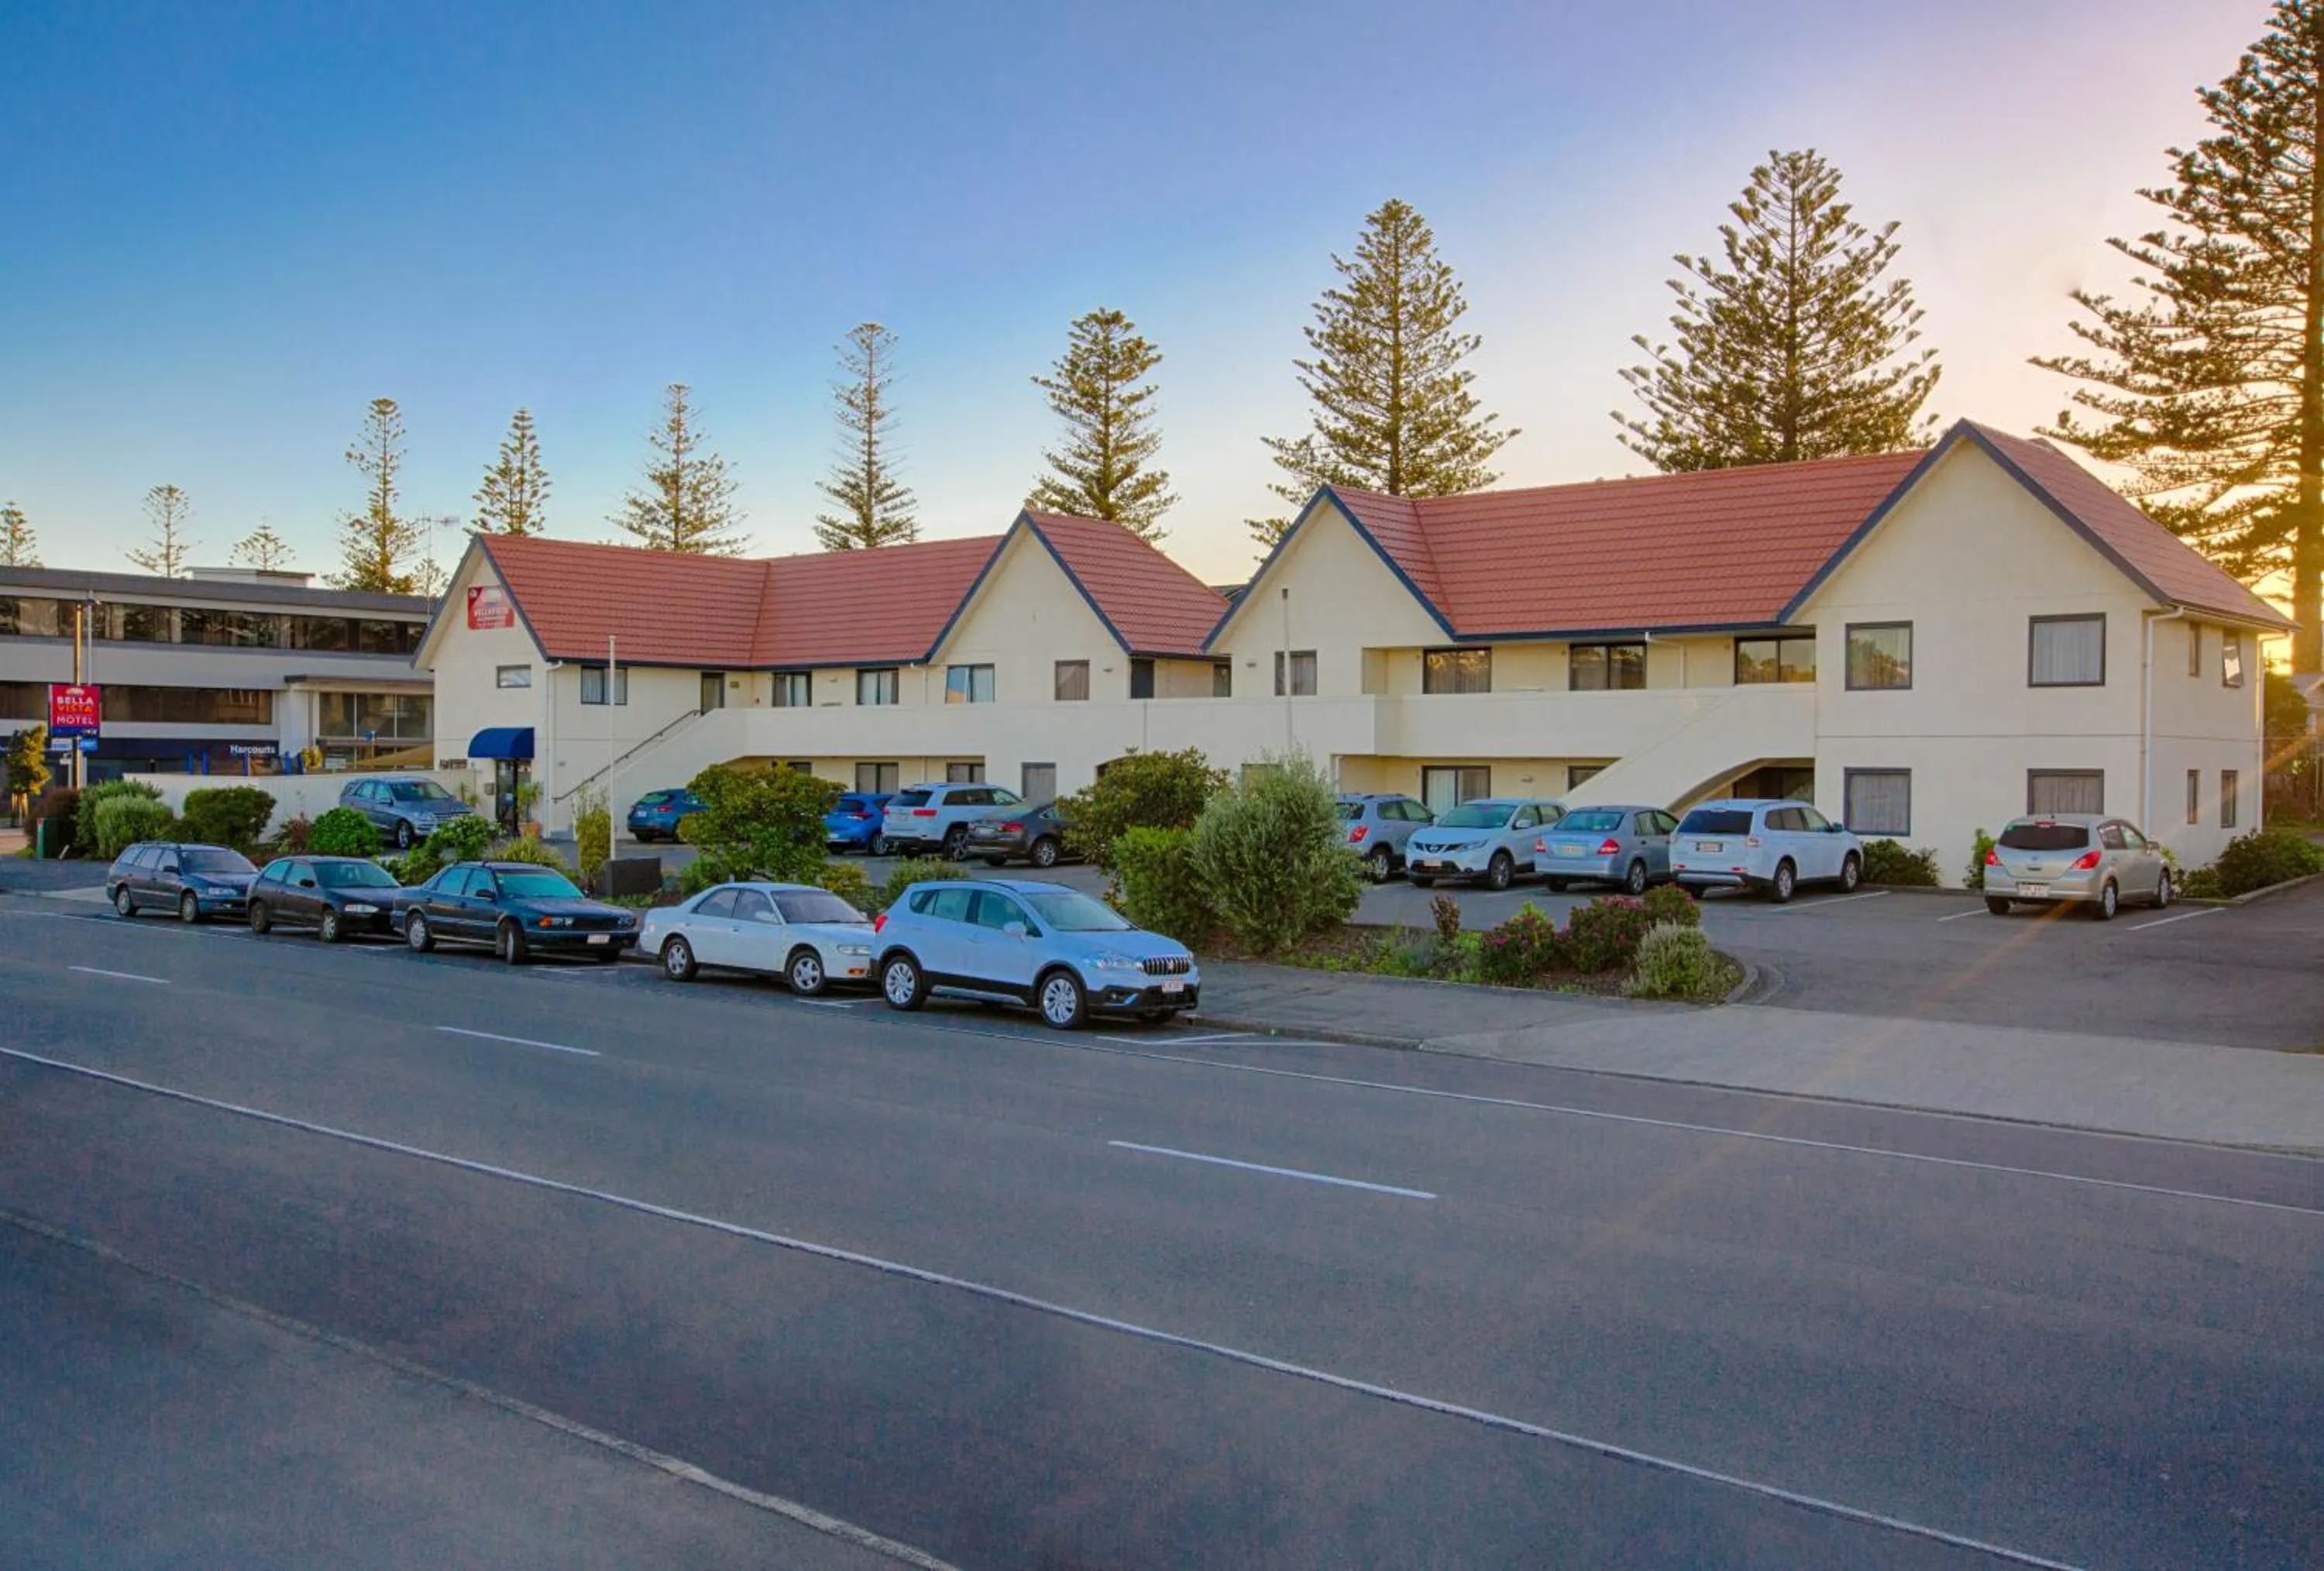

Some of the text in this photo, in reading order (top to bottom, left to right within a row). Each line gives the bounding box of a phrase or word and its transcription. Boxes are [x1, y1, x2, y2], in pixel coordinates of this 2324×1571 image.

[57, 696, 94, 705] BELLA
[57, 715, 94, 725] MOTEL
[230, 744, 276, 754] Harcourts
